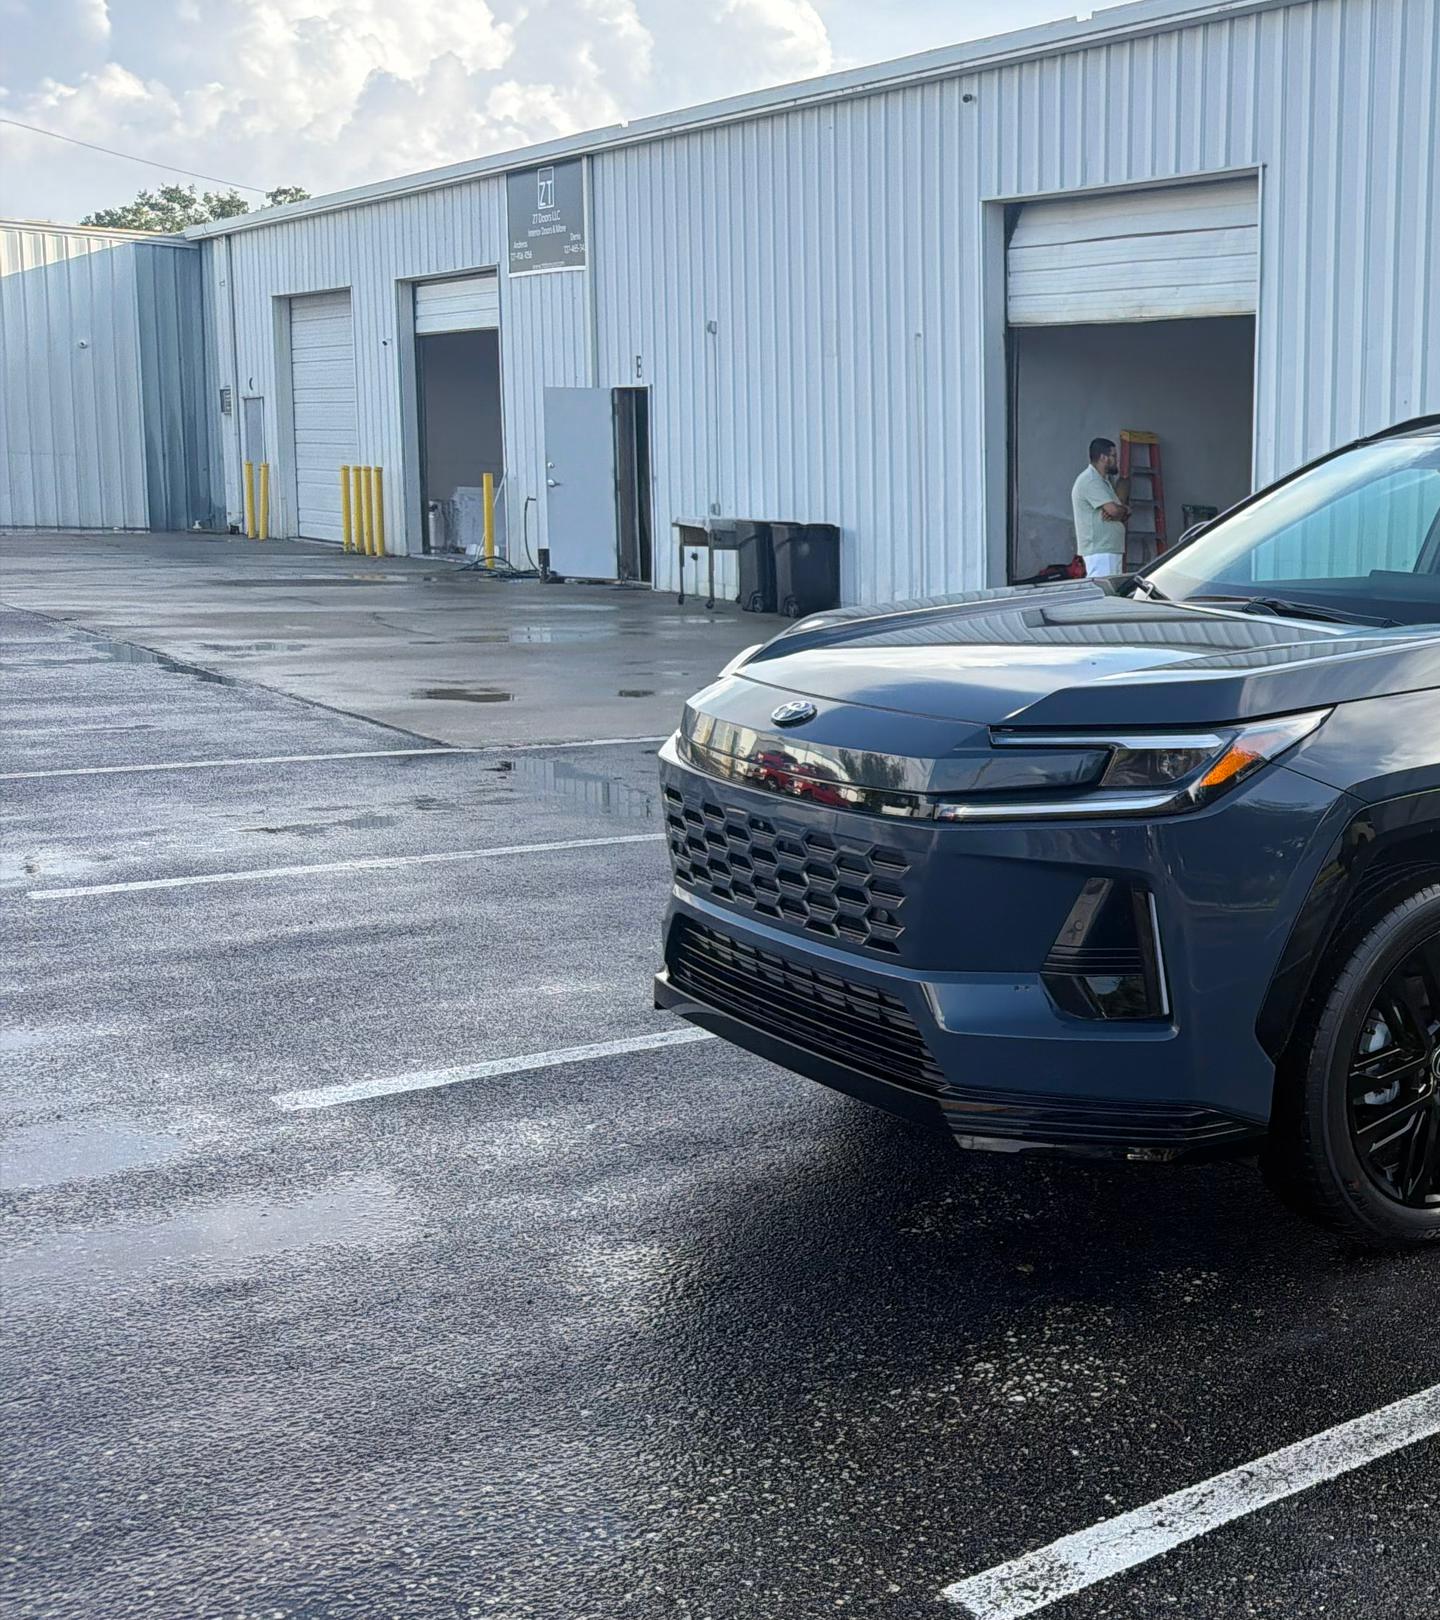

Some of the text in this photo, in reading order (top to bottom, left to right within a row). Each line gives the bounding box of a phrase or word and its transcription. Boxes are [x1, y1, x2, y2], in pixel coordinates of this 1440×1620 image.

[539, 180, 553, 206] ZT
[538, 213, 552, 223] Doors
[552, 210, 561, 221] LLC
